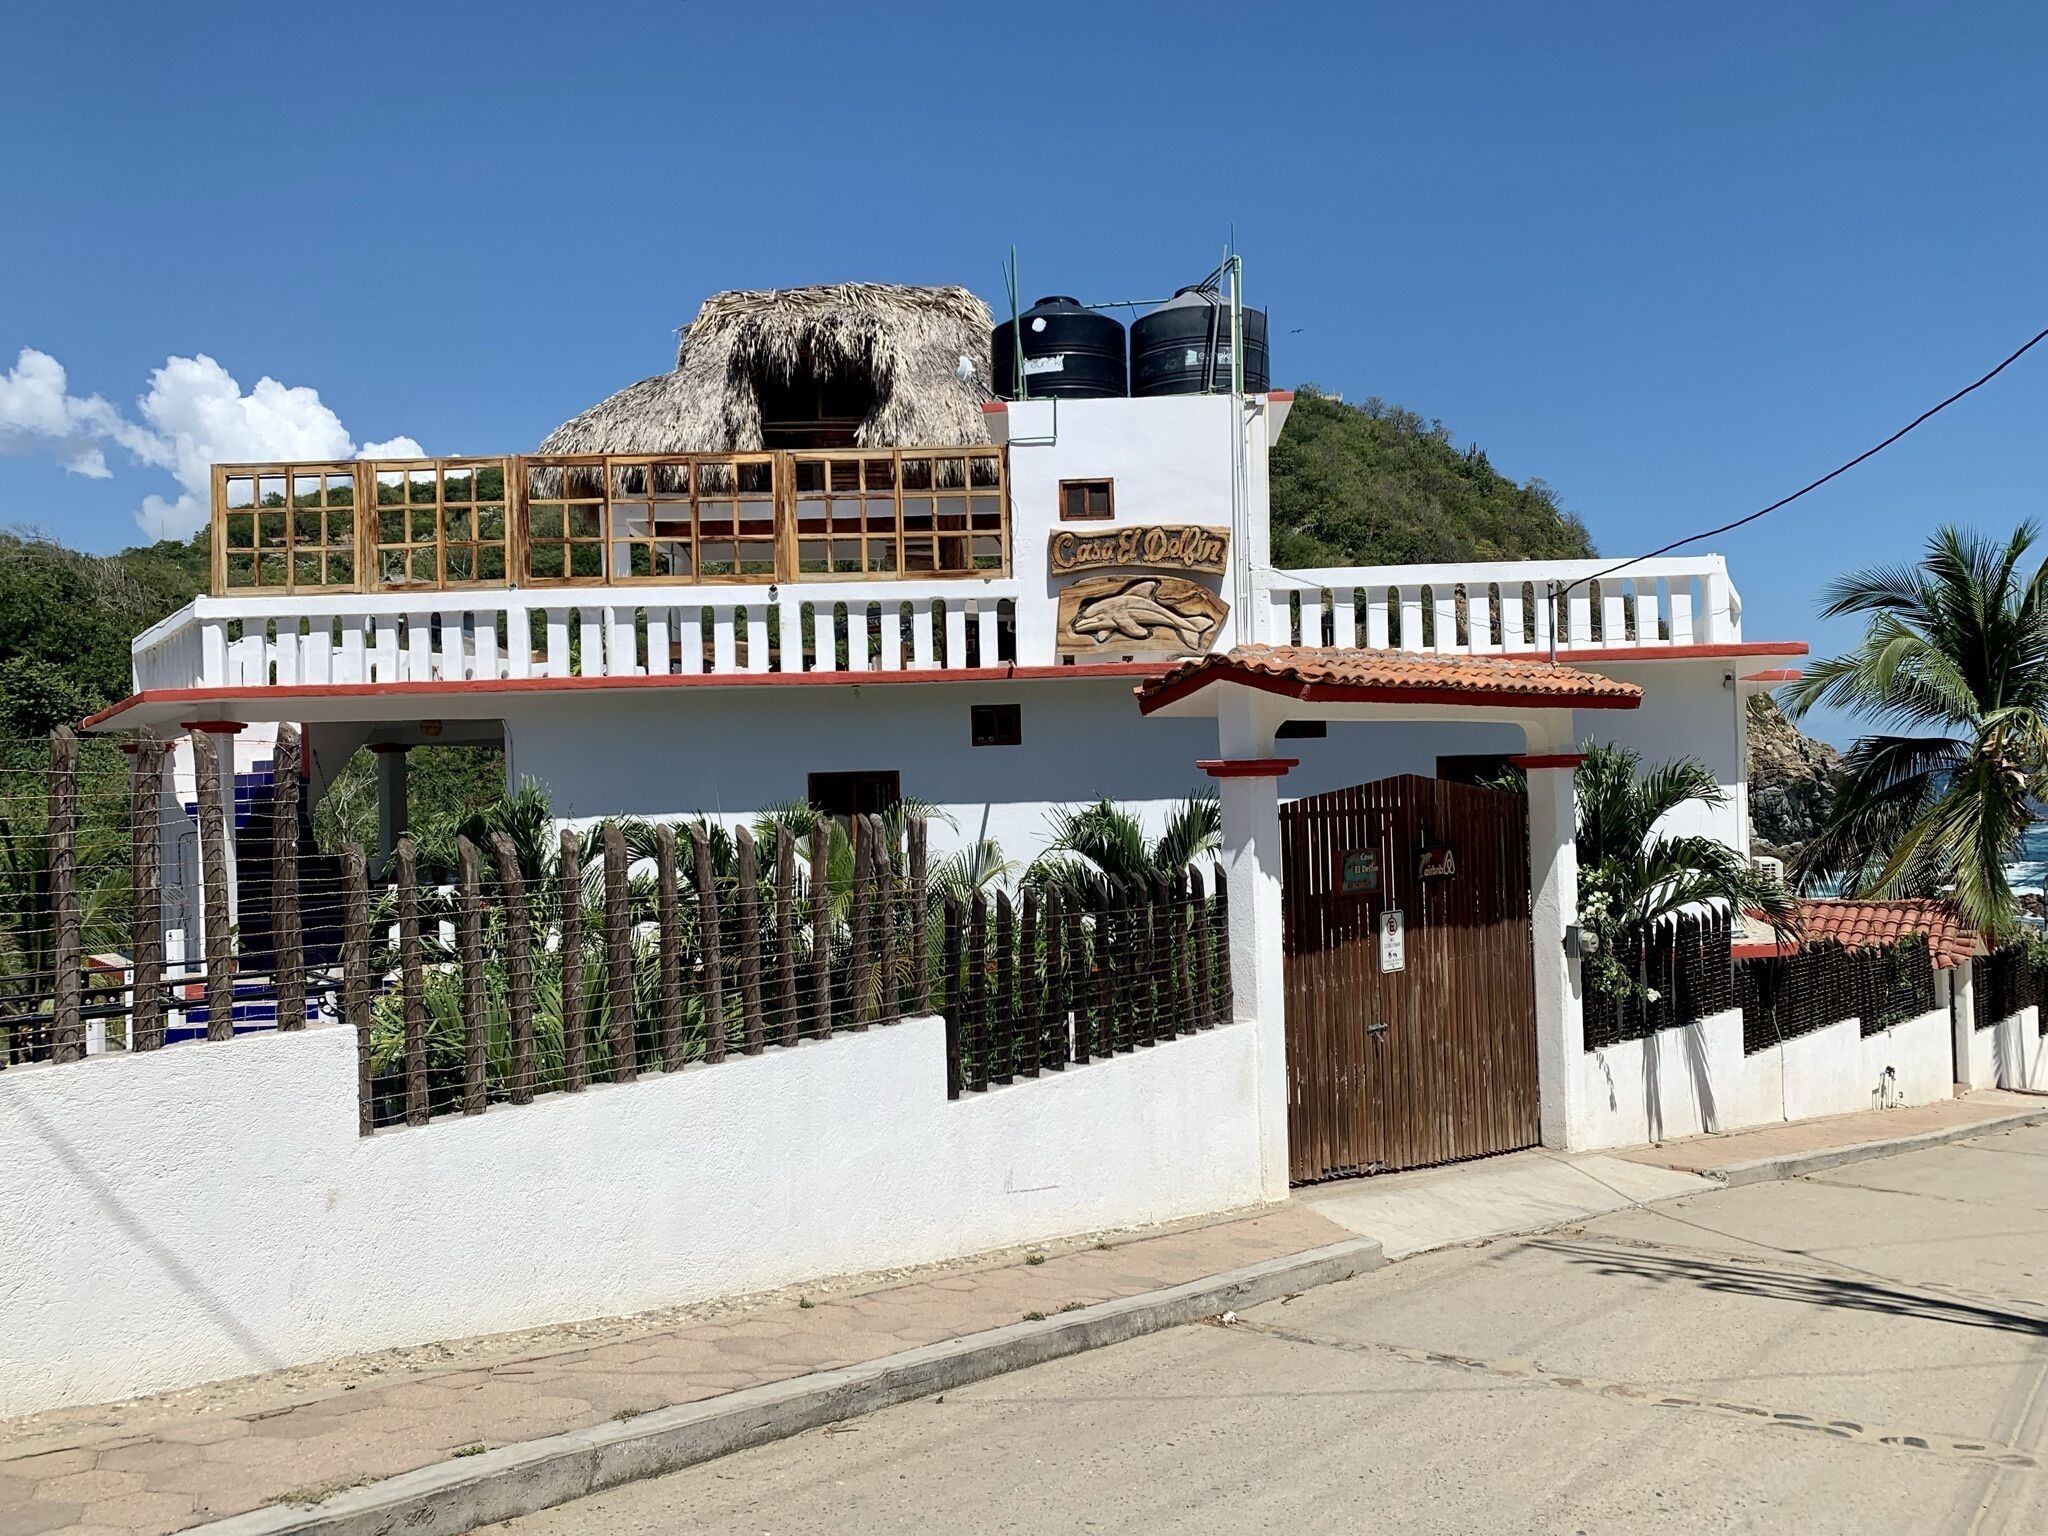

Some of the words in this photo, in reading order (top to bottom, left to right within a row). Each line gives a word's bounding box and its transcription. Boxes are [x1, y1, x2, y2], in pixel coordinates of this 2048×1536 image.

[1053, 532, 1117, 568] Casa
[1115, 528, 1144, 564] El
[1423, 864, 1444, 876] airbnb
